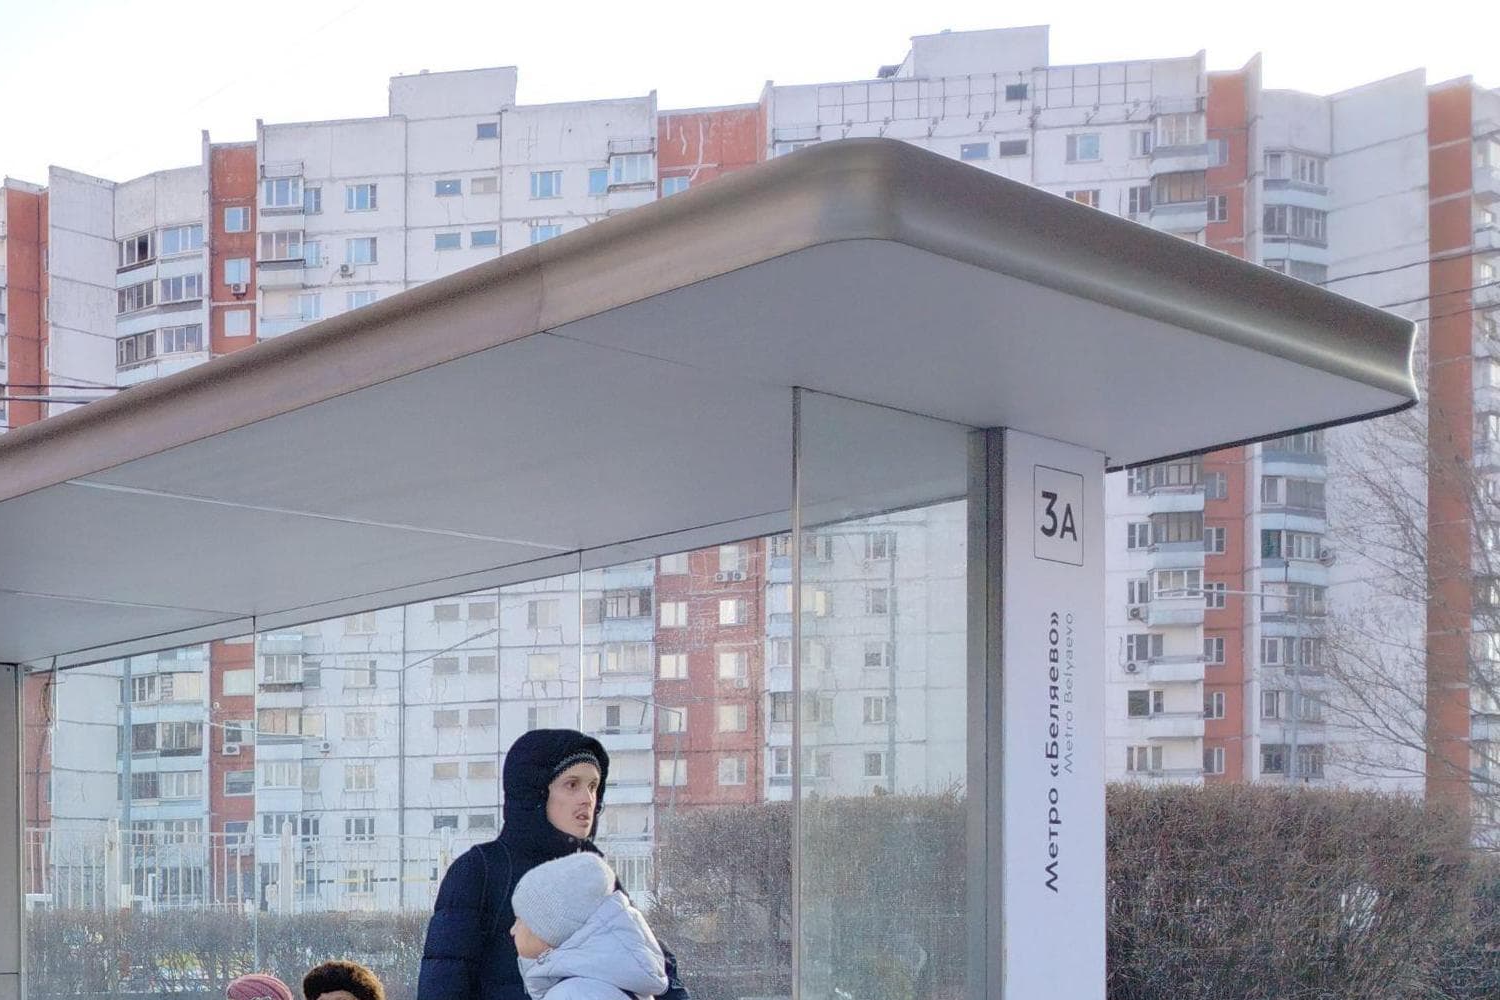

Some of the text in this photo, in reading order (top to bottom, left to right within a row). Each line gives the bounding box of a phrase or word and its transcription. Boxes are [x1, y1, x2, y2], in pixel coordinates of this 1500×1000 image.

[1045, 611, 1062, 893] Метро «Беляево»
[1064, 613, 1075, 773] Metro Belyaevo
